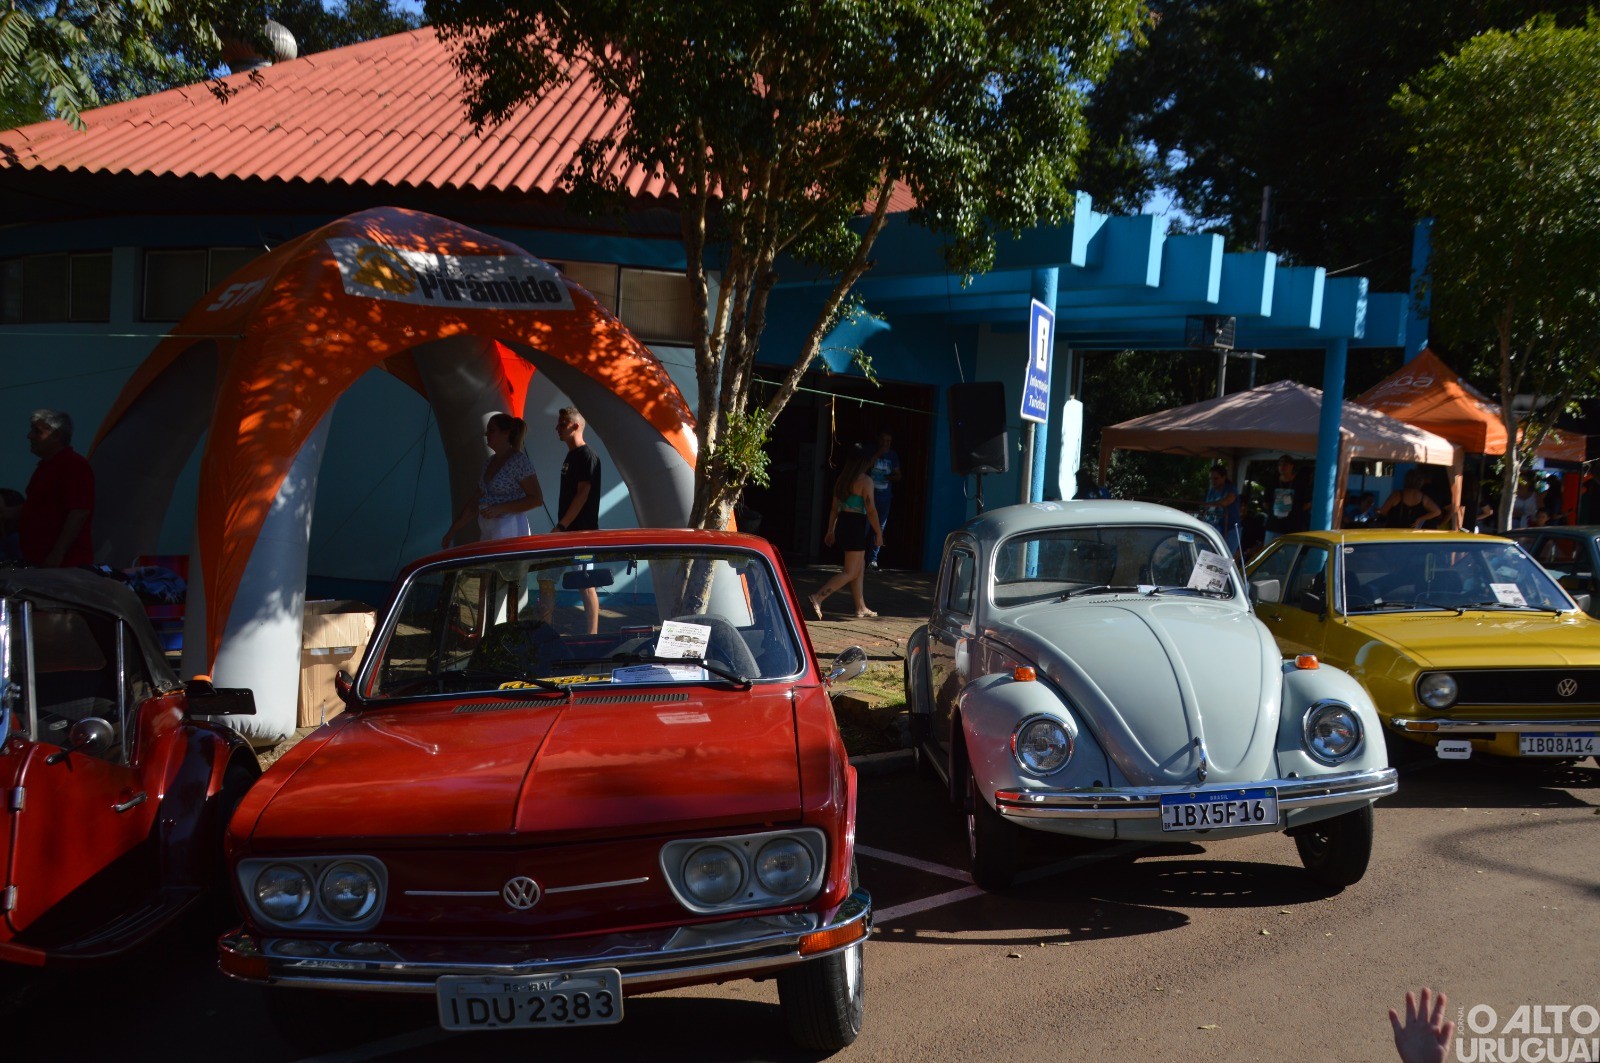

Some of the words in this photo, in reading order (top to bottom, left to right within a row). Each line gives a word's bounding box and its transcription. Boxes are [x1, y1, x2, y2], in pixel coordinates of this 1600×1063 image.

[416, 271, 562, 303] Pirâmide
[1527, 737, 1594, 753] IBQ8A14
[1171, 800, 1266, 827] IBX5F16
